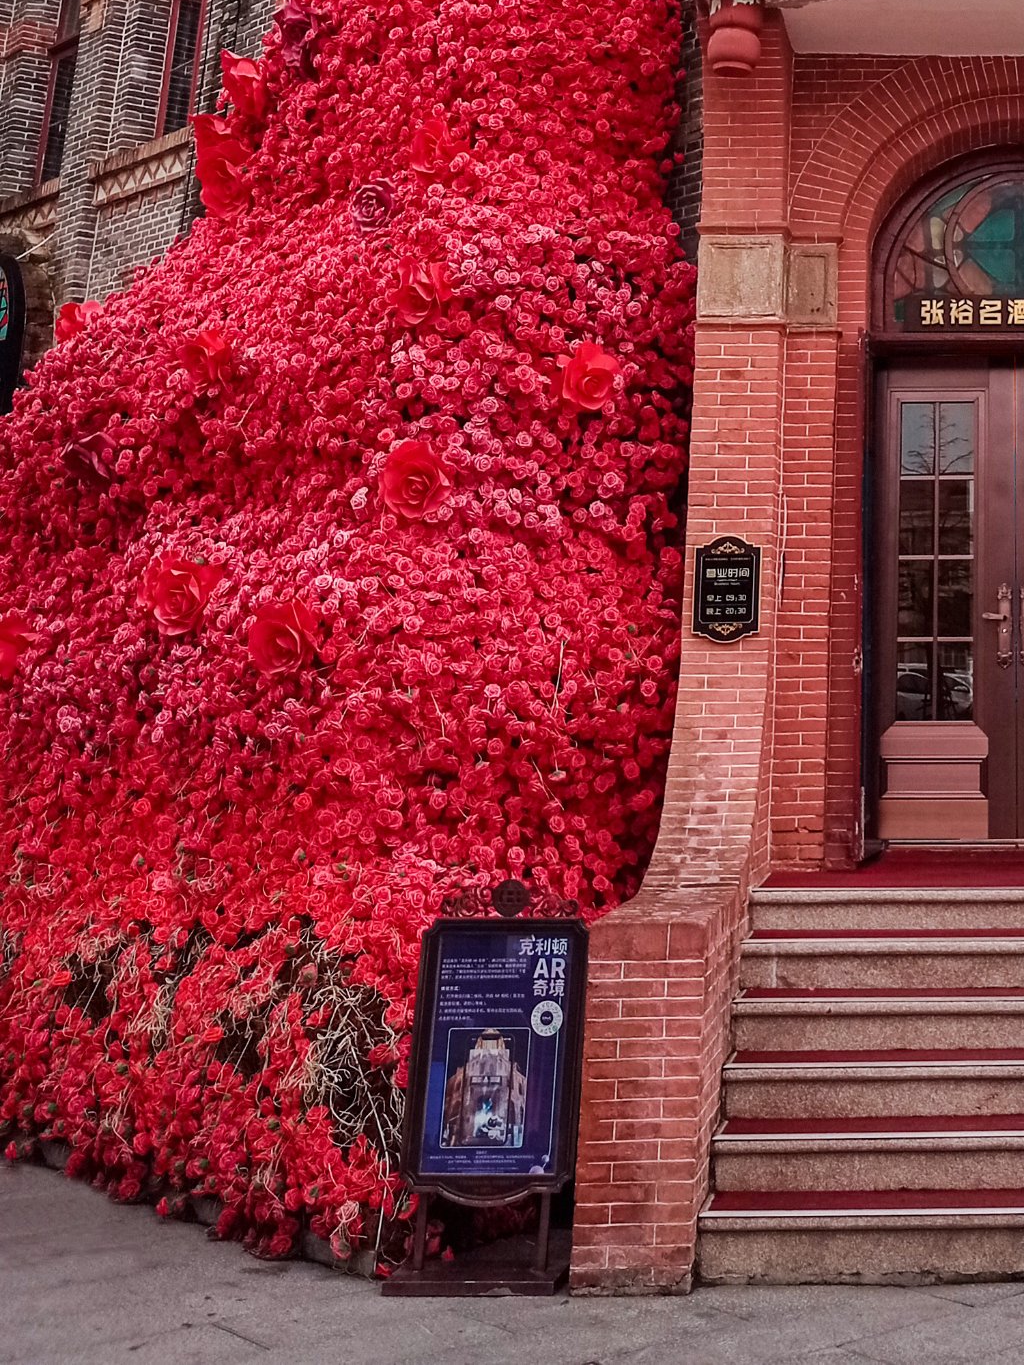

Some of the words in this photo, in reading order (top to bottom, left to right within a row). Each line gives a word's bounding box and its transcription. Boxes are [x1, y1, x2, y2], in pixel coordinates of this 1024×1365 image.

[706, 568, 750, 578] 营业时间
[725, 594, 747, 602] 09:30
[725, 607, 747, 615] 20:30
[518, 937, 568, 956] 克利顿
[533, 958, 566, 979] AR
[532, 979, 565, 997] 奇境
